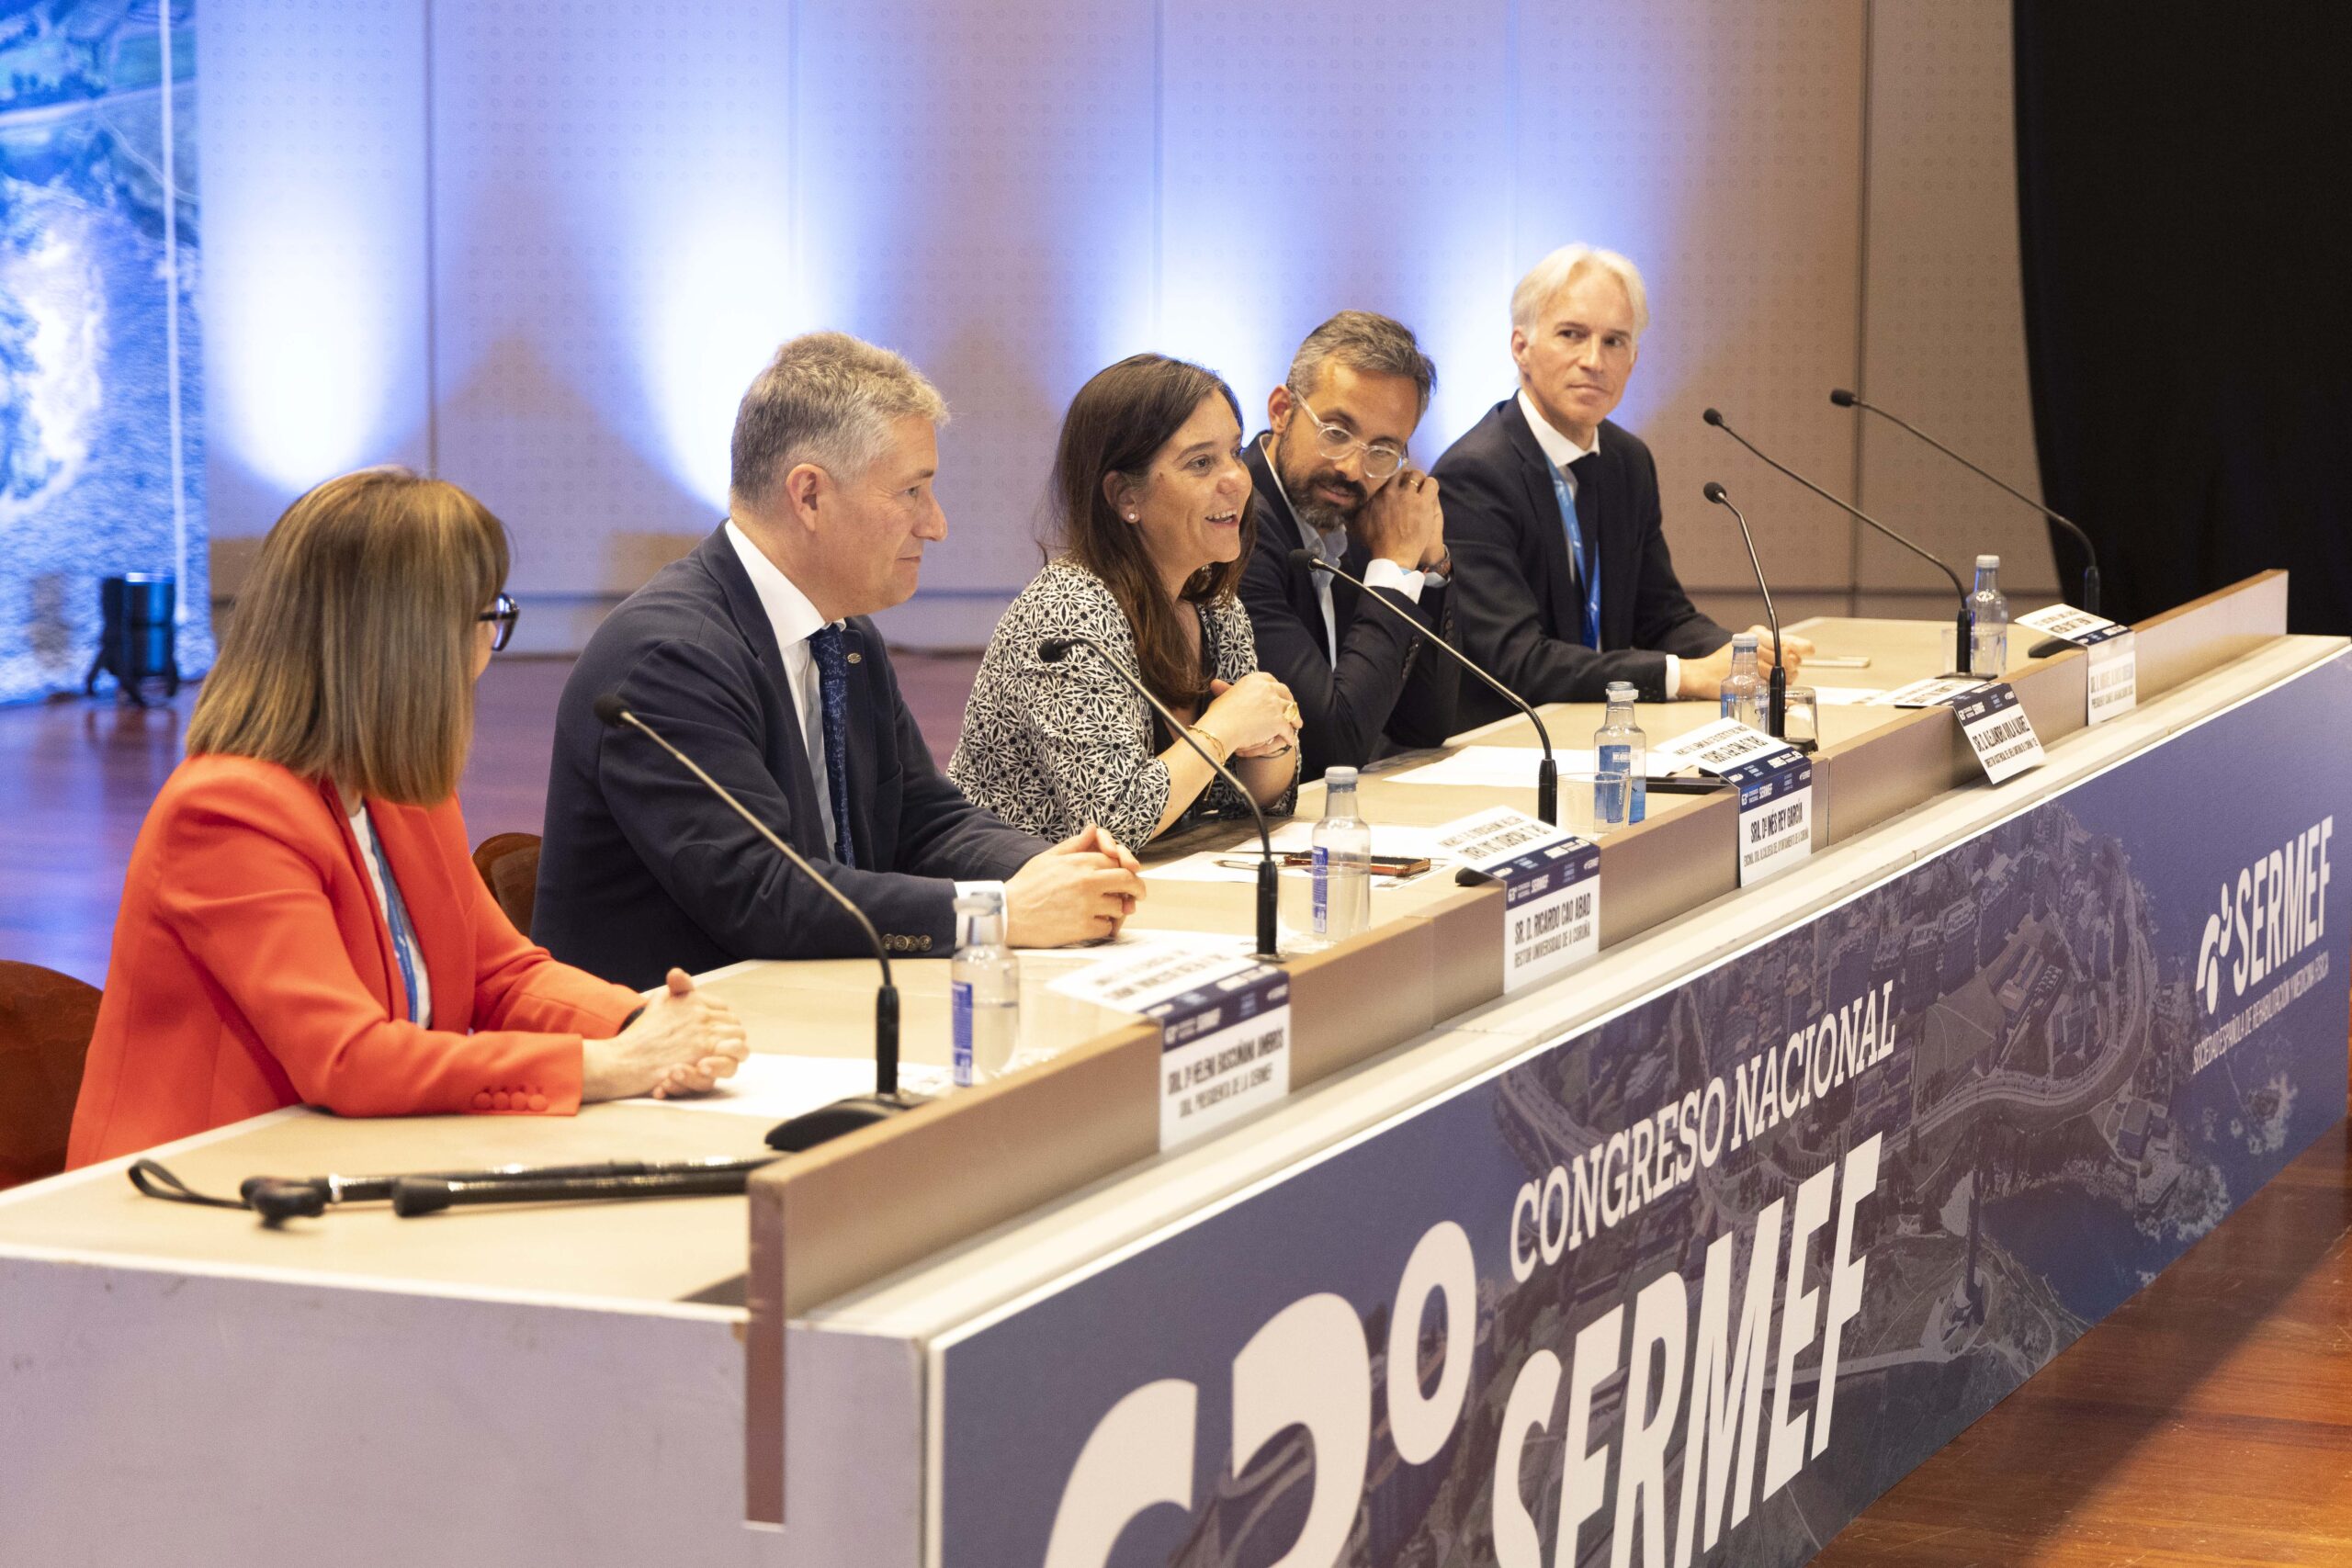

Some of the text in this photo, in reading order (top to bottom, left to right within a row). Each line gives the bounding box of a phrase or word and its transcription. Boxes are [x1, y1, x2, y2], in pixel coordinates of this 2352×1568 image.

[1750, 819, 1760, 843] SRA.
[1768, 808, 1776, 835] INÉS
[1787, 797, 1802, 828] GARCÍA
[1515, 893, 1590, 944] SR. D. RICARDO CAO ABAD
[1532, 934, 1561, 961] UNIVERSIDAD
[1562, 931, 1567, 947] DE
[1573, 919, 1589, 942] CORUÑA
[2233, 815, 2333, 997] SERMEF
[1510, 980, 1896, 1283] CONGRESO NACIONAL
[1492, 1131, 1883, 1568] SERMEF
